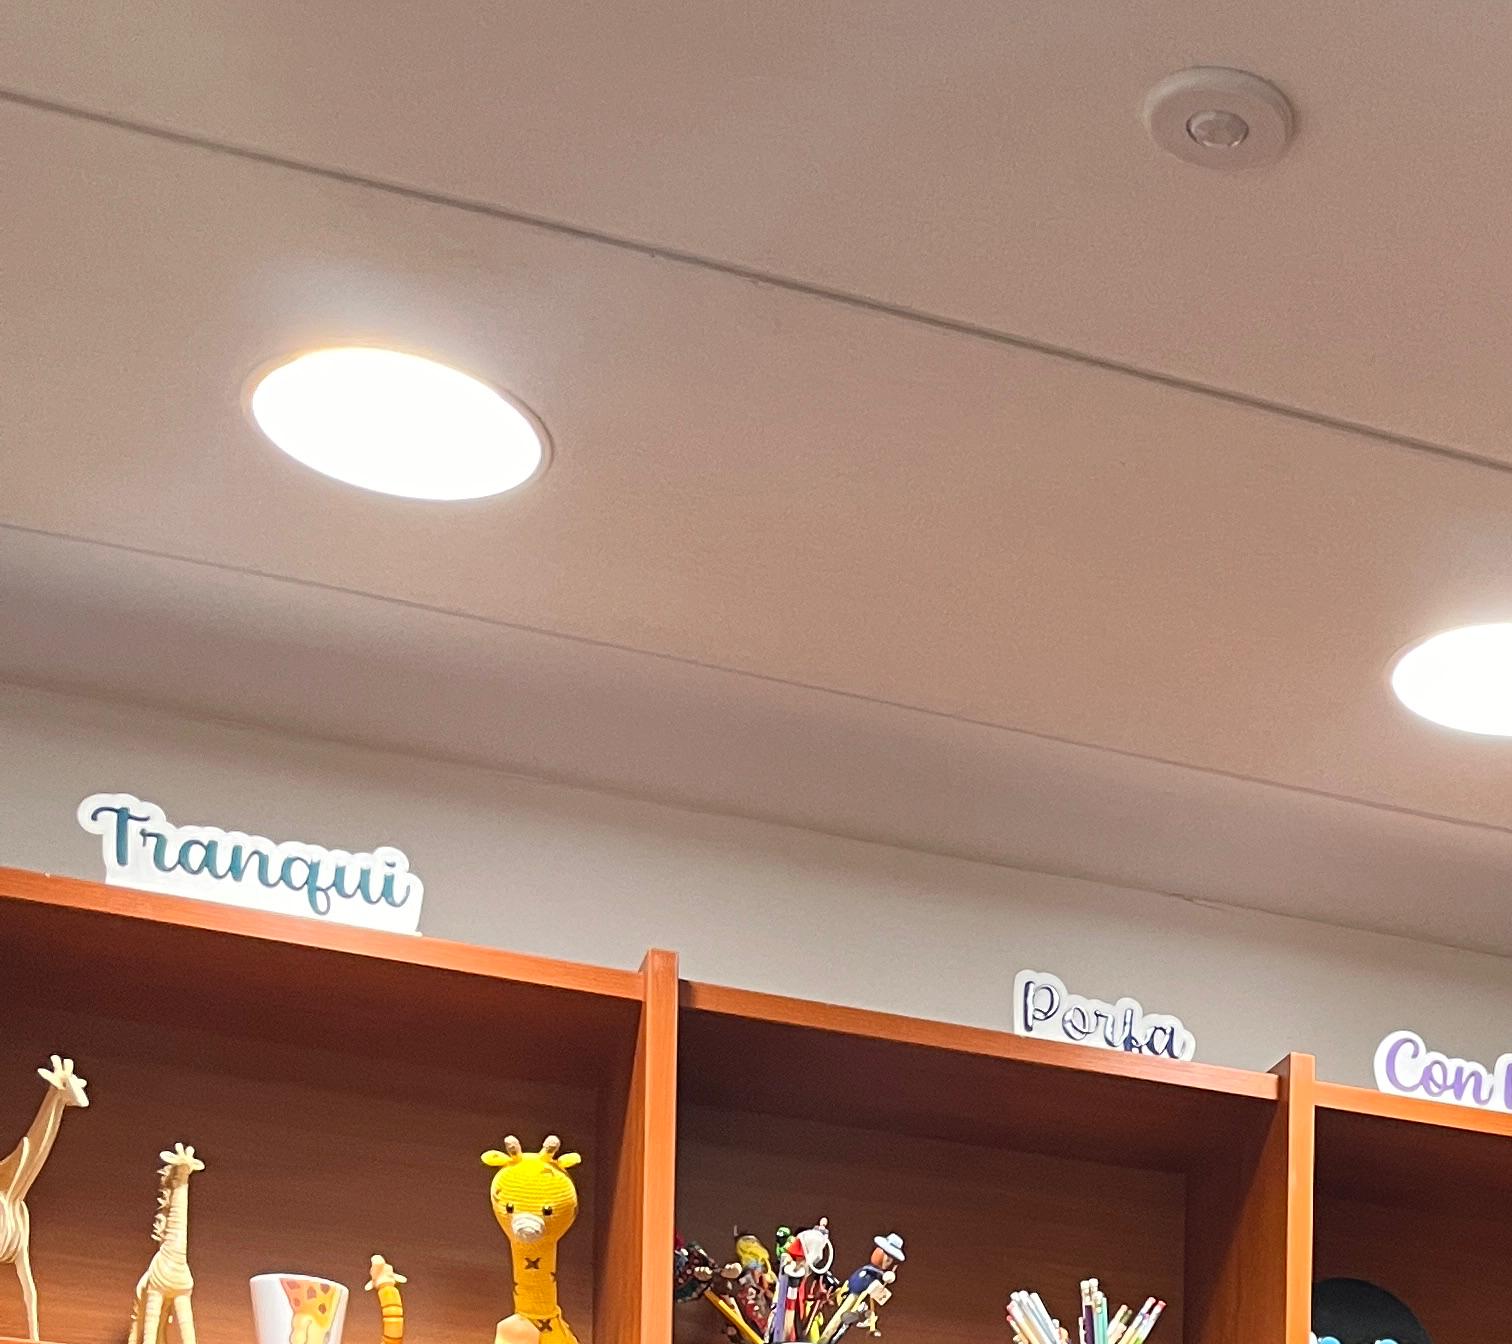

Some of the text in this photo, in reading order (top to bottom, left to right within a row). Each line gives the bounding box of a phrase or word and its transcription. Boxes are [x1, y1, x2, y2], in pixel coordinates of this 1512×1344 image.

[91, 805, 411, 916] Tranqui
[1022, 979, 1186, 1061] Porfa
[1385, 1037, 1493, 1106] Con
